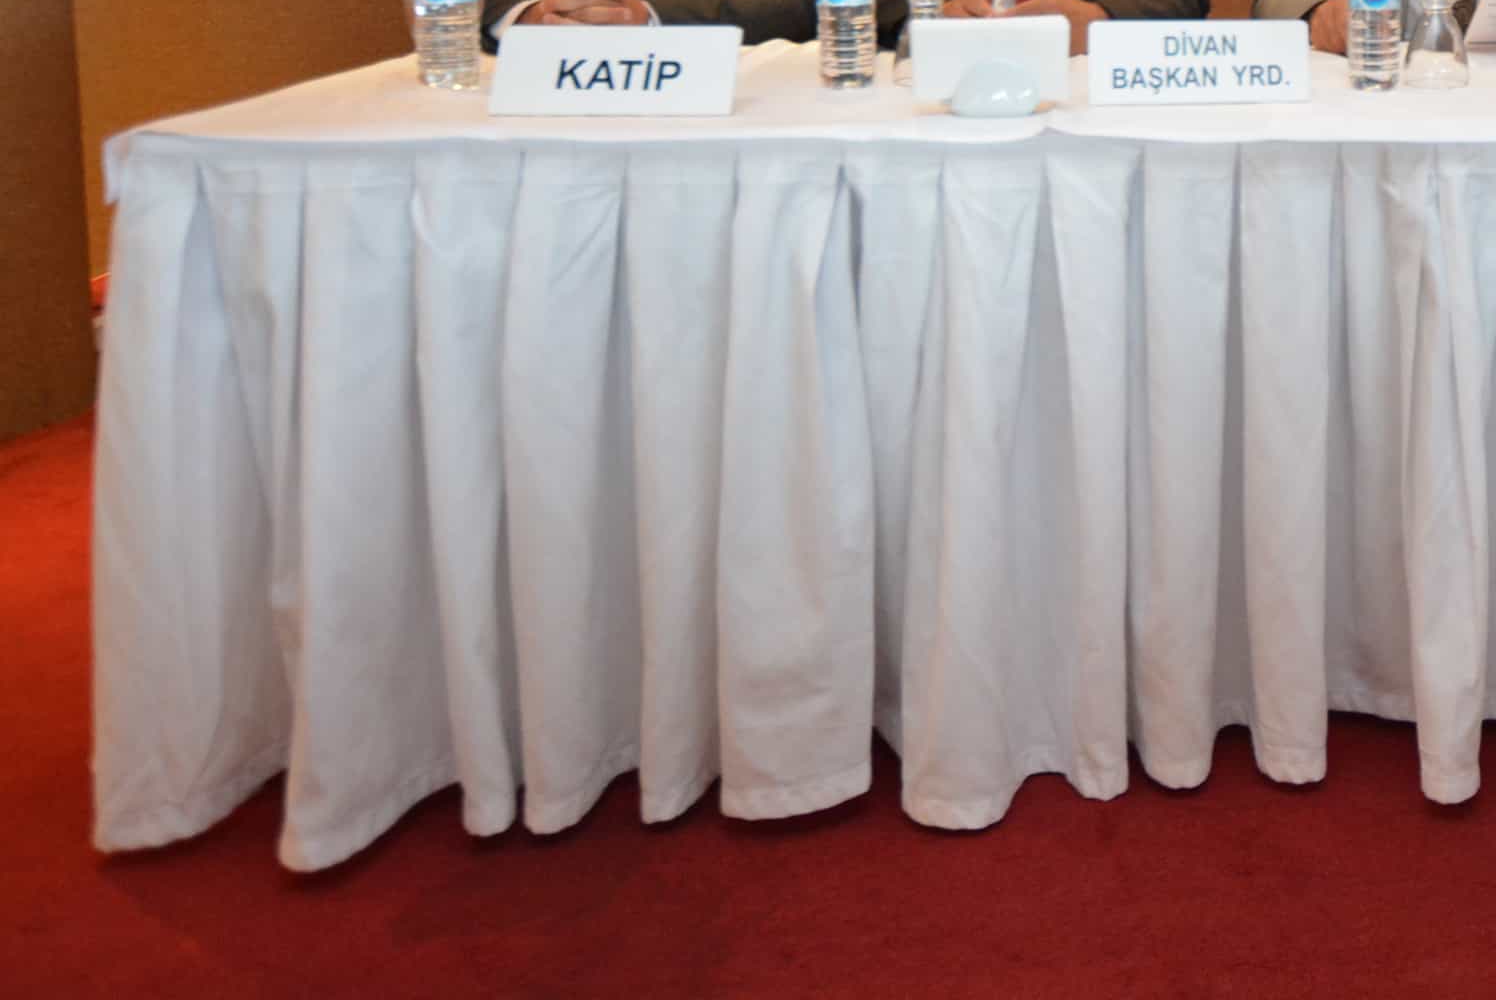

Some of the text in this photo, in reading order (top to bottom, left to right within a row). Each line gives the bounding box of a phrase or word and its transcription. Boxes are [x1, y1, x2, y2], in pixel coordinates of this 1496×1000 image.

[1164, 31, 1238, 57] DİVAN
[555, 52, 683, 91] KATİP
[1112, 64, 1292, 96] BAŞKAN YRD.
